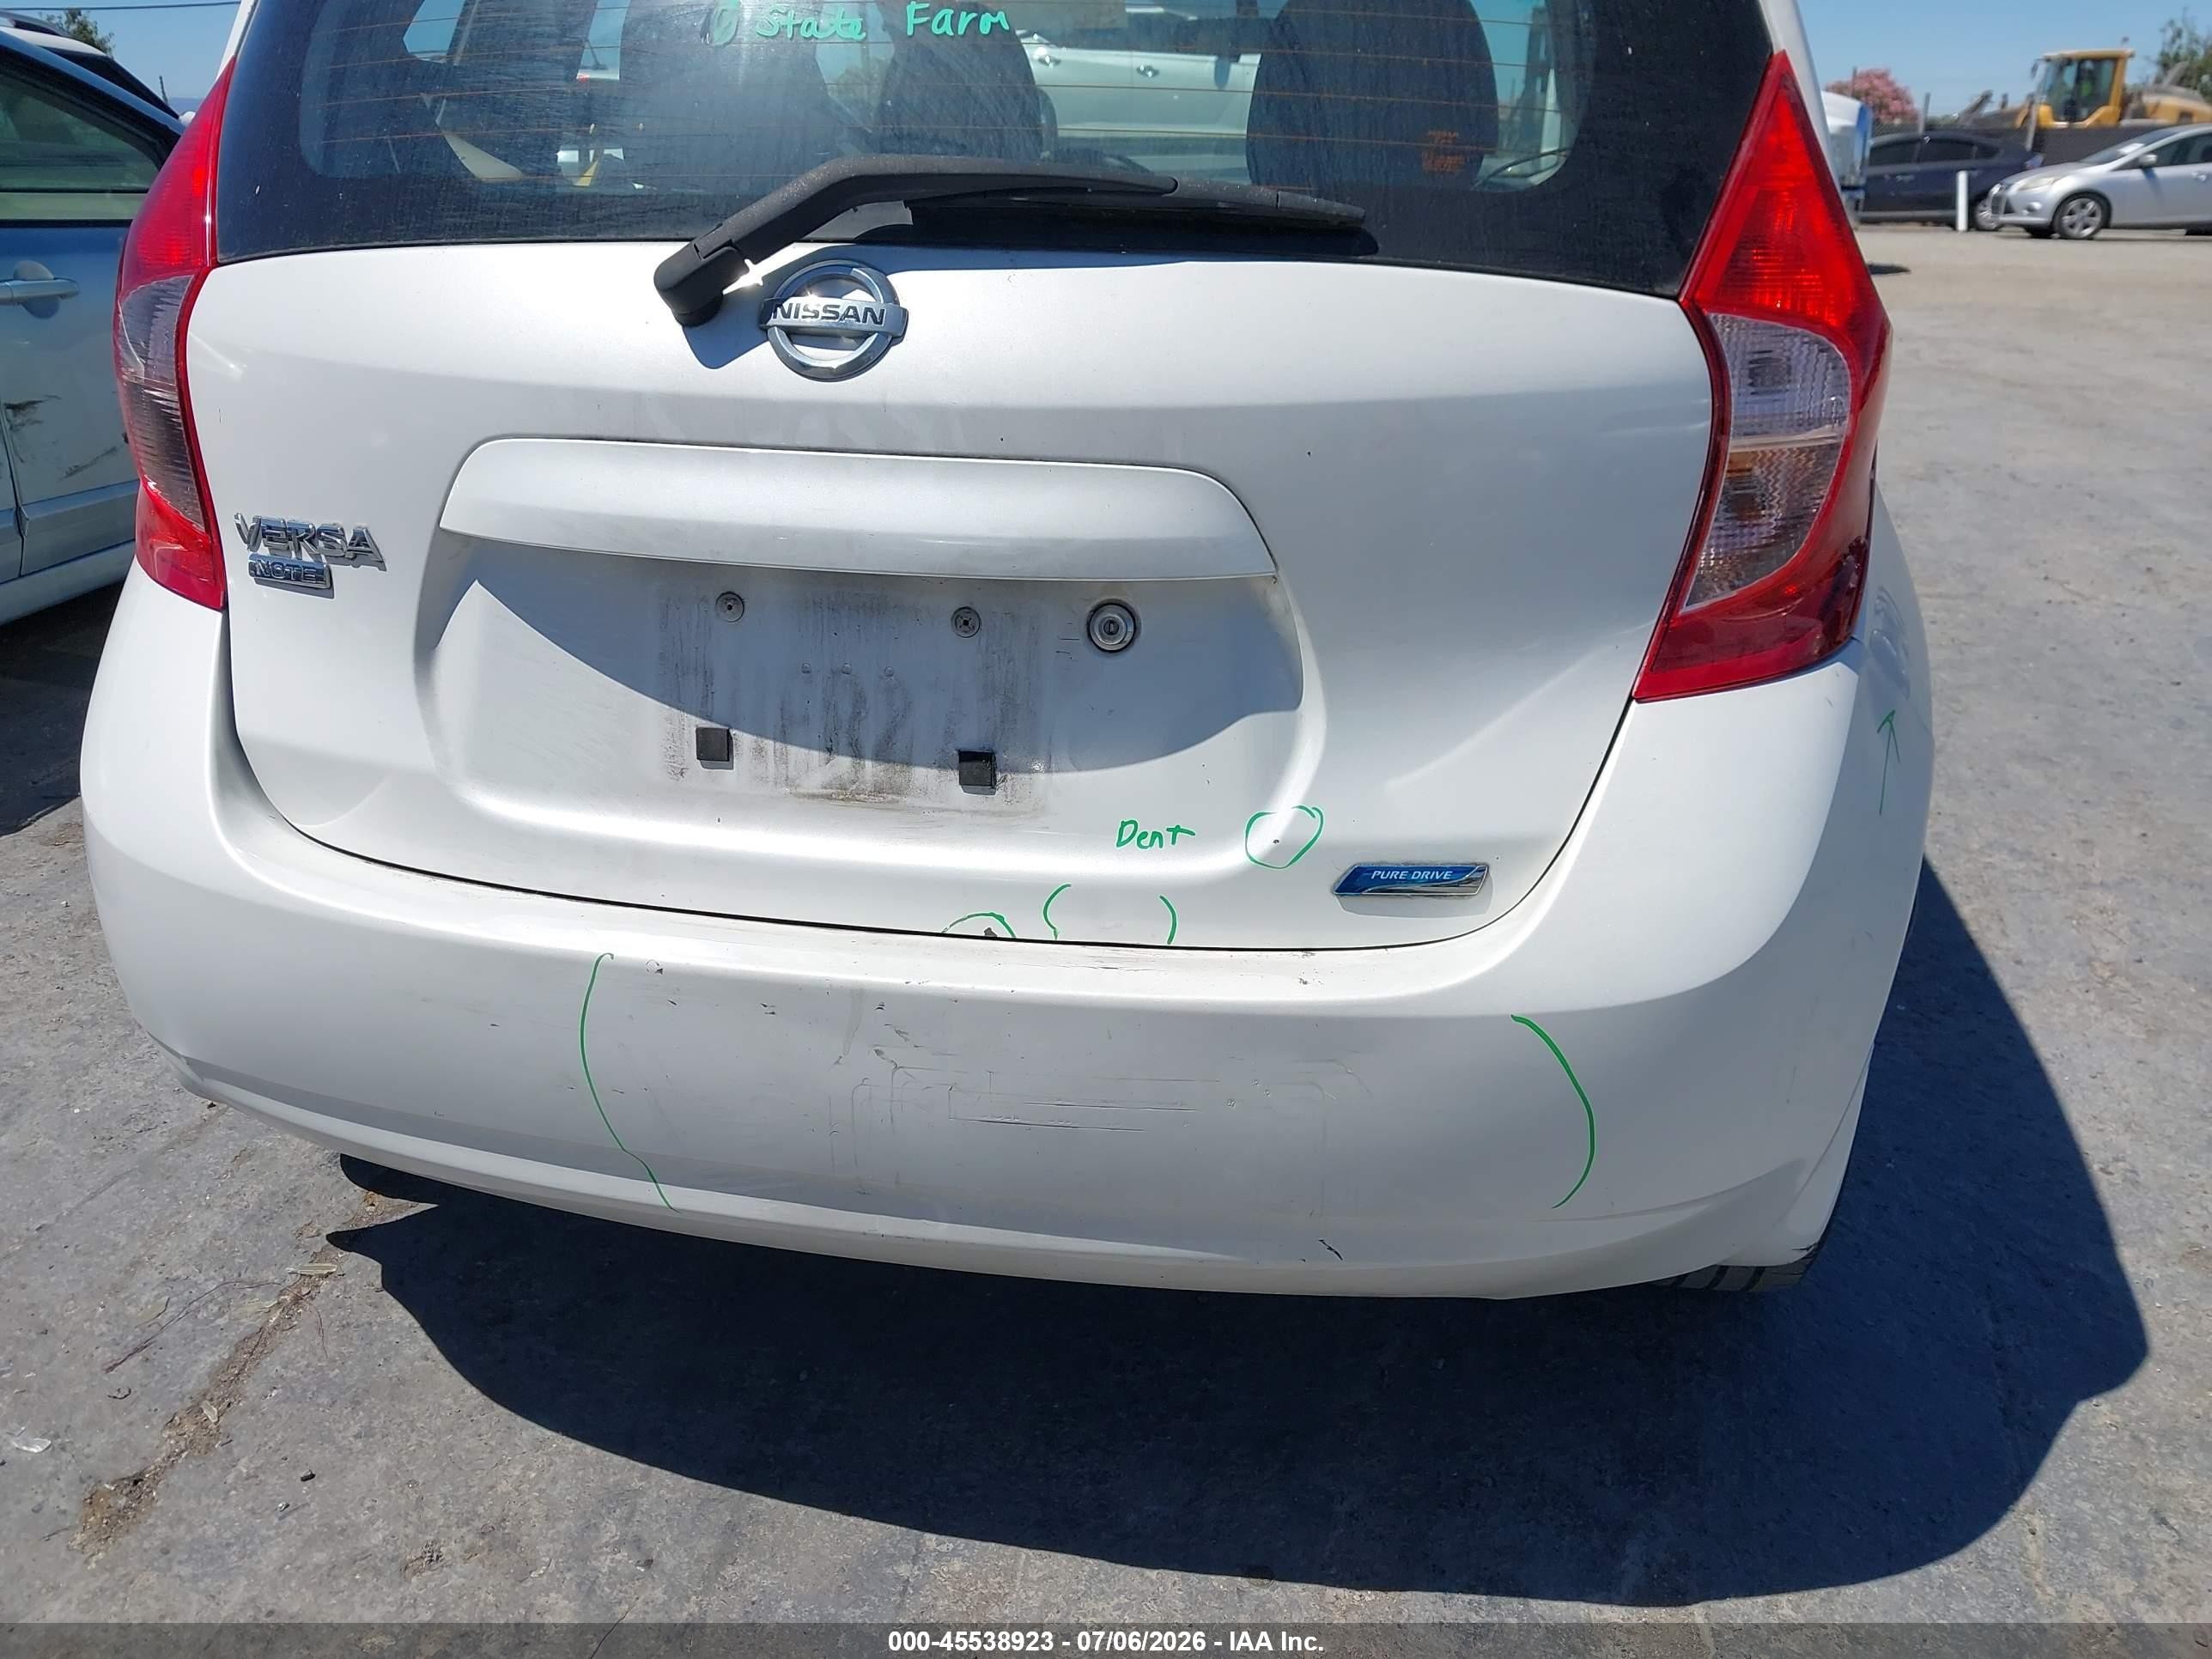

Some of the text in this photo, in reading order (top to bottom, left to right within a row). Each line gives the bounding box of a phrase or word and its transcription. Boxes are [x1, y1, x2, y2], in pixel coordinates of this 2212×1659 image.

[755, 1, 1011, 40] State Farm
[773, 301, 886, 325] NISSAN
[234, 513, 385, 564] VERSA
[256, 559, 319, 585] NOTE
[1115, 819, 1196, 850] Dent
[1371, 871, 1453, 879] PURE DRIVE
